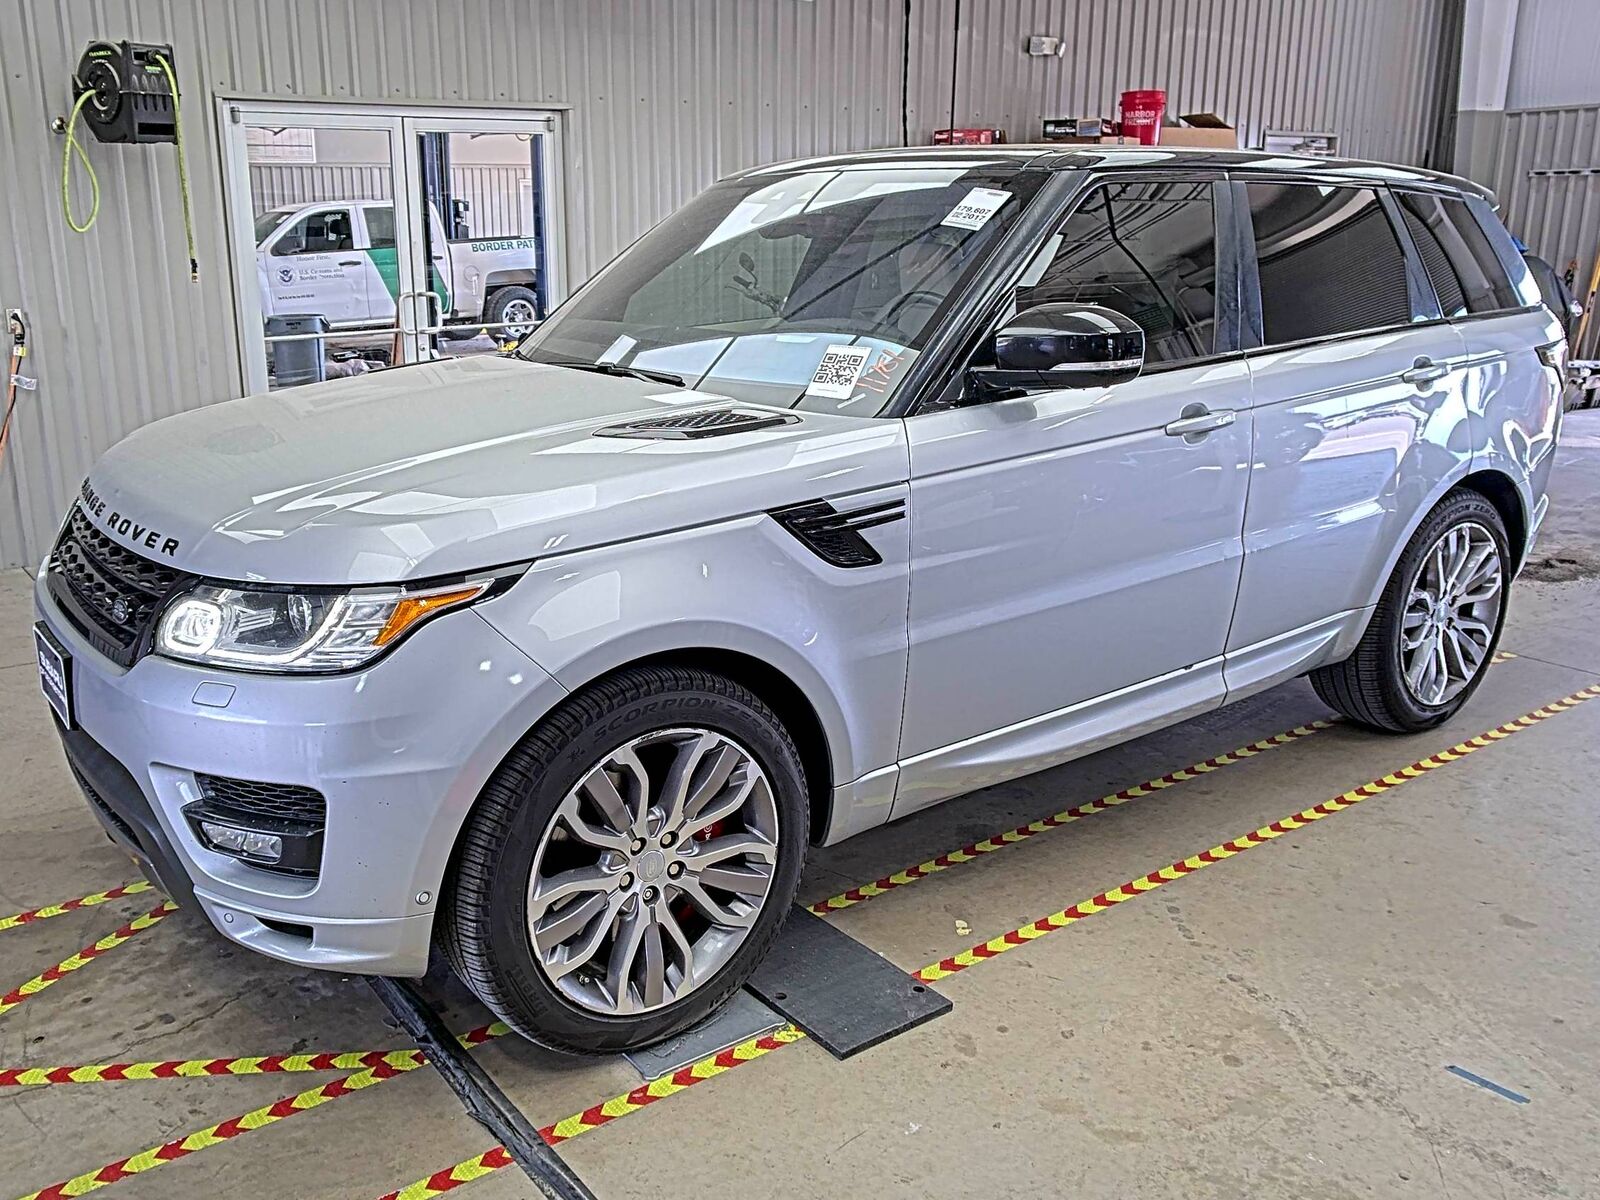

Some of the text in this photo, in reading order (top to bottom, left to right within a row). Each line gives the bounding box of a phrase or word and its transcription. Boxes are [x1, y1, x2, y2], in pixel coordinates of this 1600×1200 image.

[1125, 110, 1156, 118] HARBOR
[956, 205, 992, 215] 179,607
[963, 213, 986, 221] 2017
[471, 240, 515, 252] BORDER
[107, 511, 180, 557] ROVER
[593, 698, 774, 744] SCORPION ZERO
